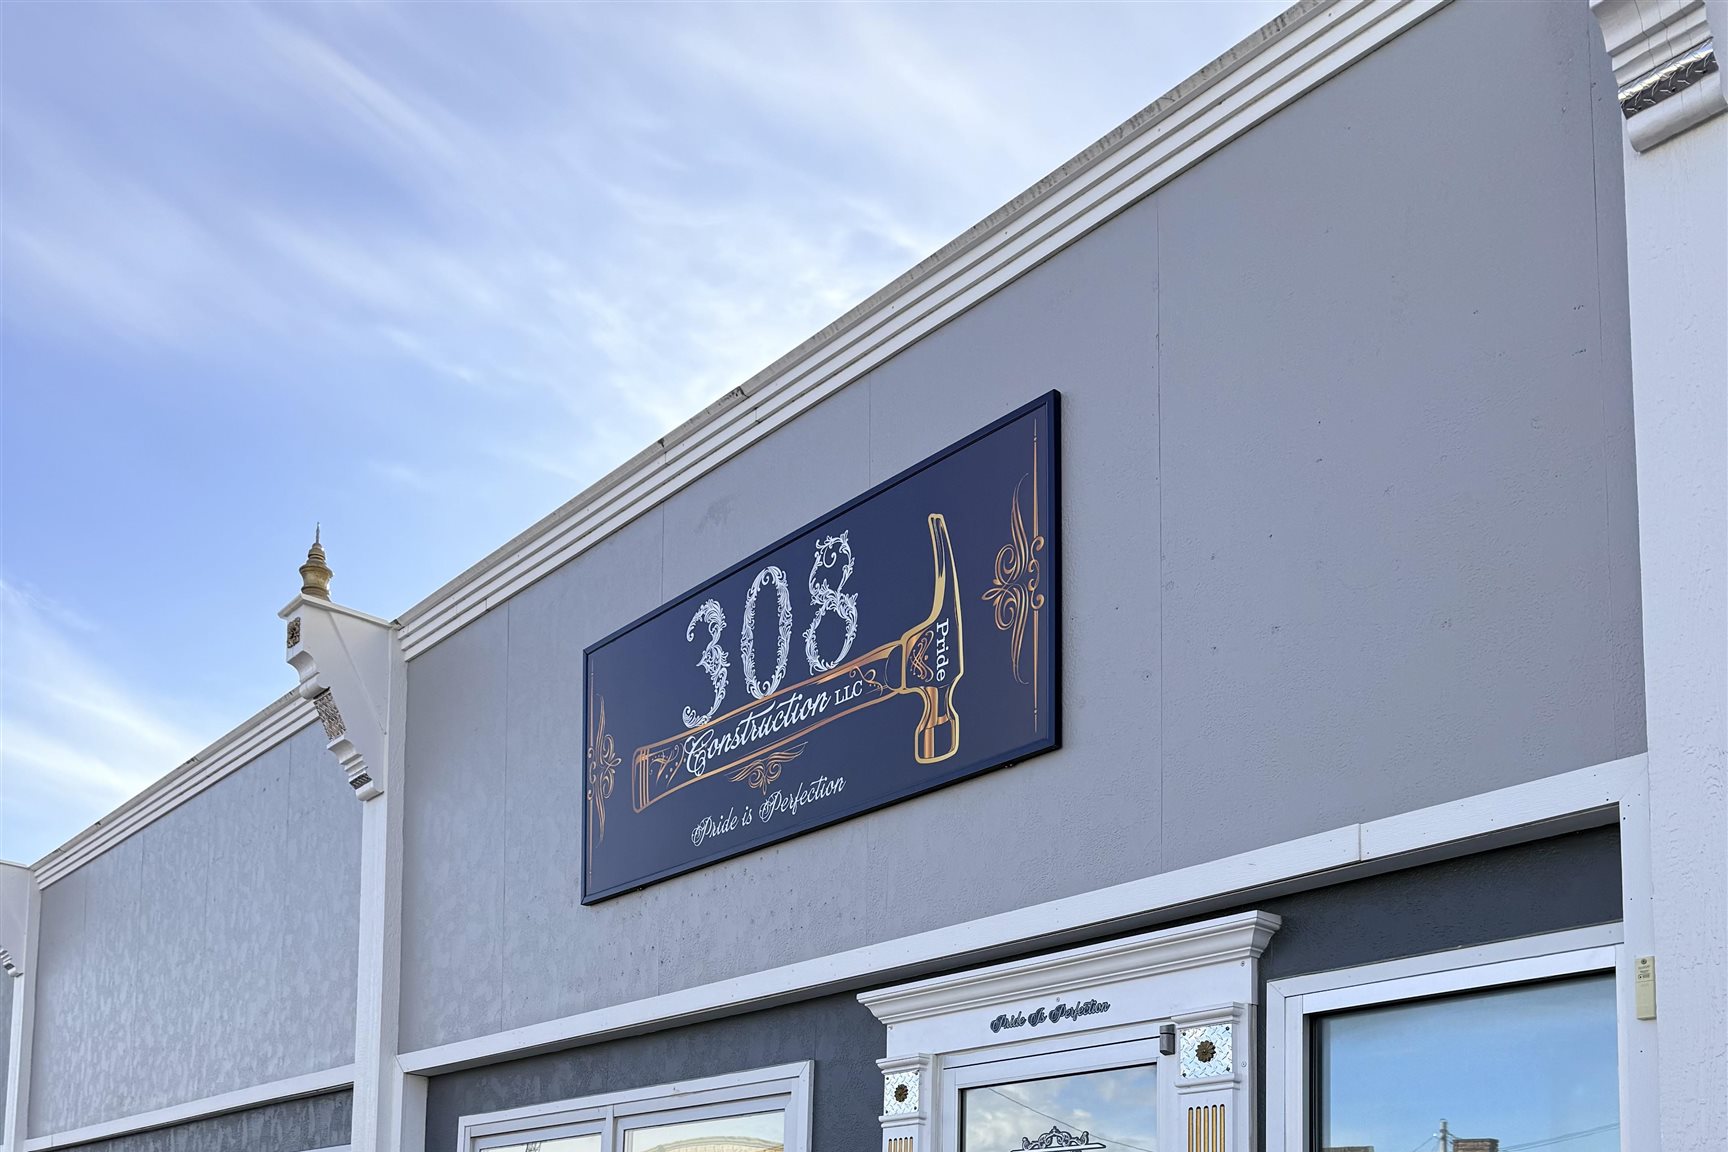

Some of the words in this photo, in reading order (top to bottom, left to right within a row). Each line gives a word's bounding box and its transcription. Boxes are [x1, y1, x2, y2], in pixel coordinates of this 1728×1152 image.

[682, 530, 859, 728] 308
[936, 617, 950, 682] Pride
[685, 691, 832, 776] Construction
[834, 680, 864, 705] LLC
[691, 806, 739, 847] Pride
[742, 805, 753, 827] is
[759, 775, 846, 823] Perfection
[990, 1012, 1026, 1033] Pride
[1028, 1006, 1048, 1027] Is
[1049, 999, 1111, 1023] Perfection
